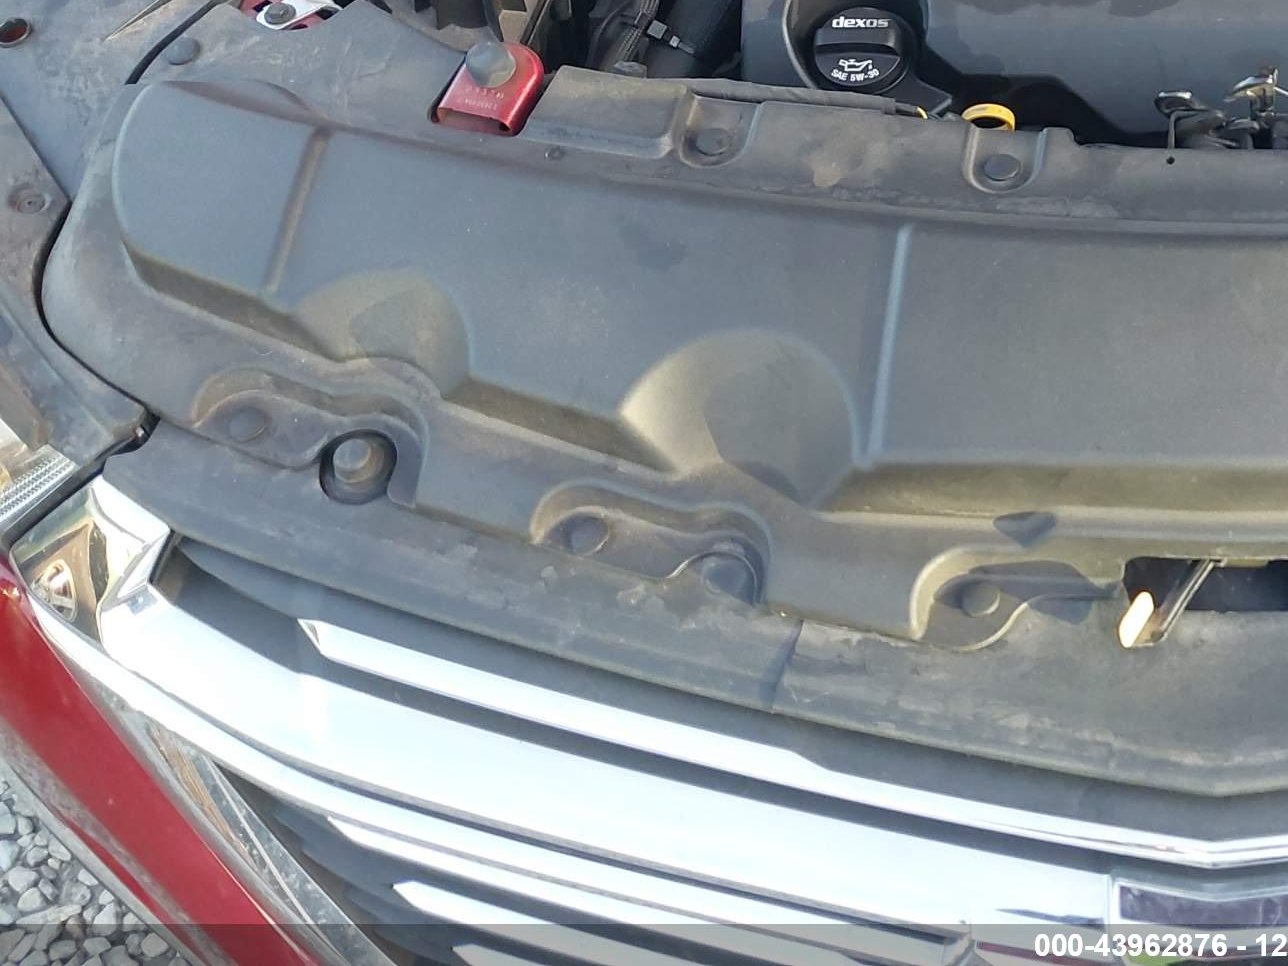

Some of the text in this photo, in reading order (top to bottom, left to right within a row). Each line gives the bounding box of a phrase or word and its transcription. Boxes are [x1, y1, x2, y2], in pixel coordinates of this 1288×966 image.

[832, 16, 893, 28] dexos
[831, 68, 880, 82] SAE 5W-30
